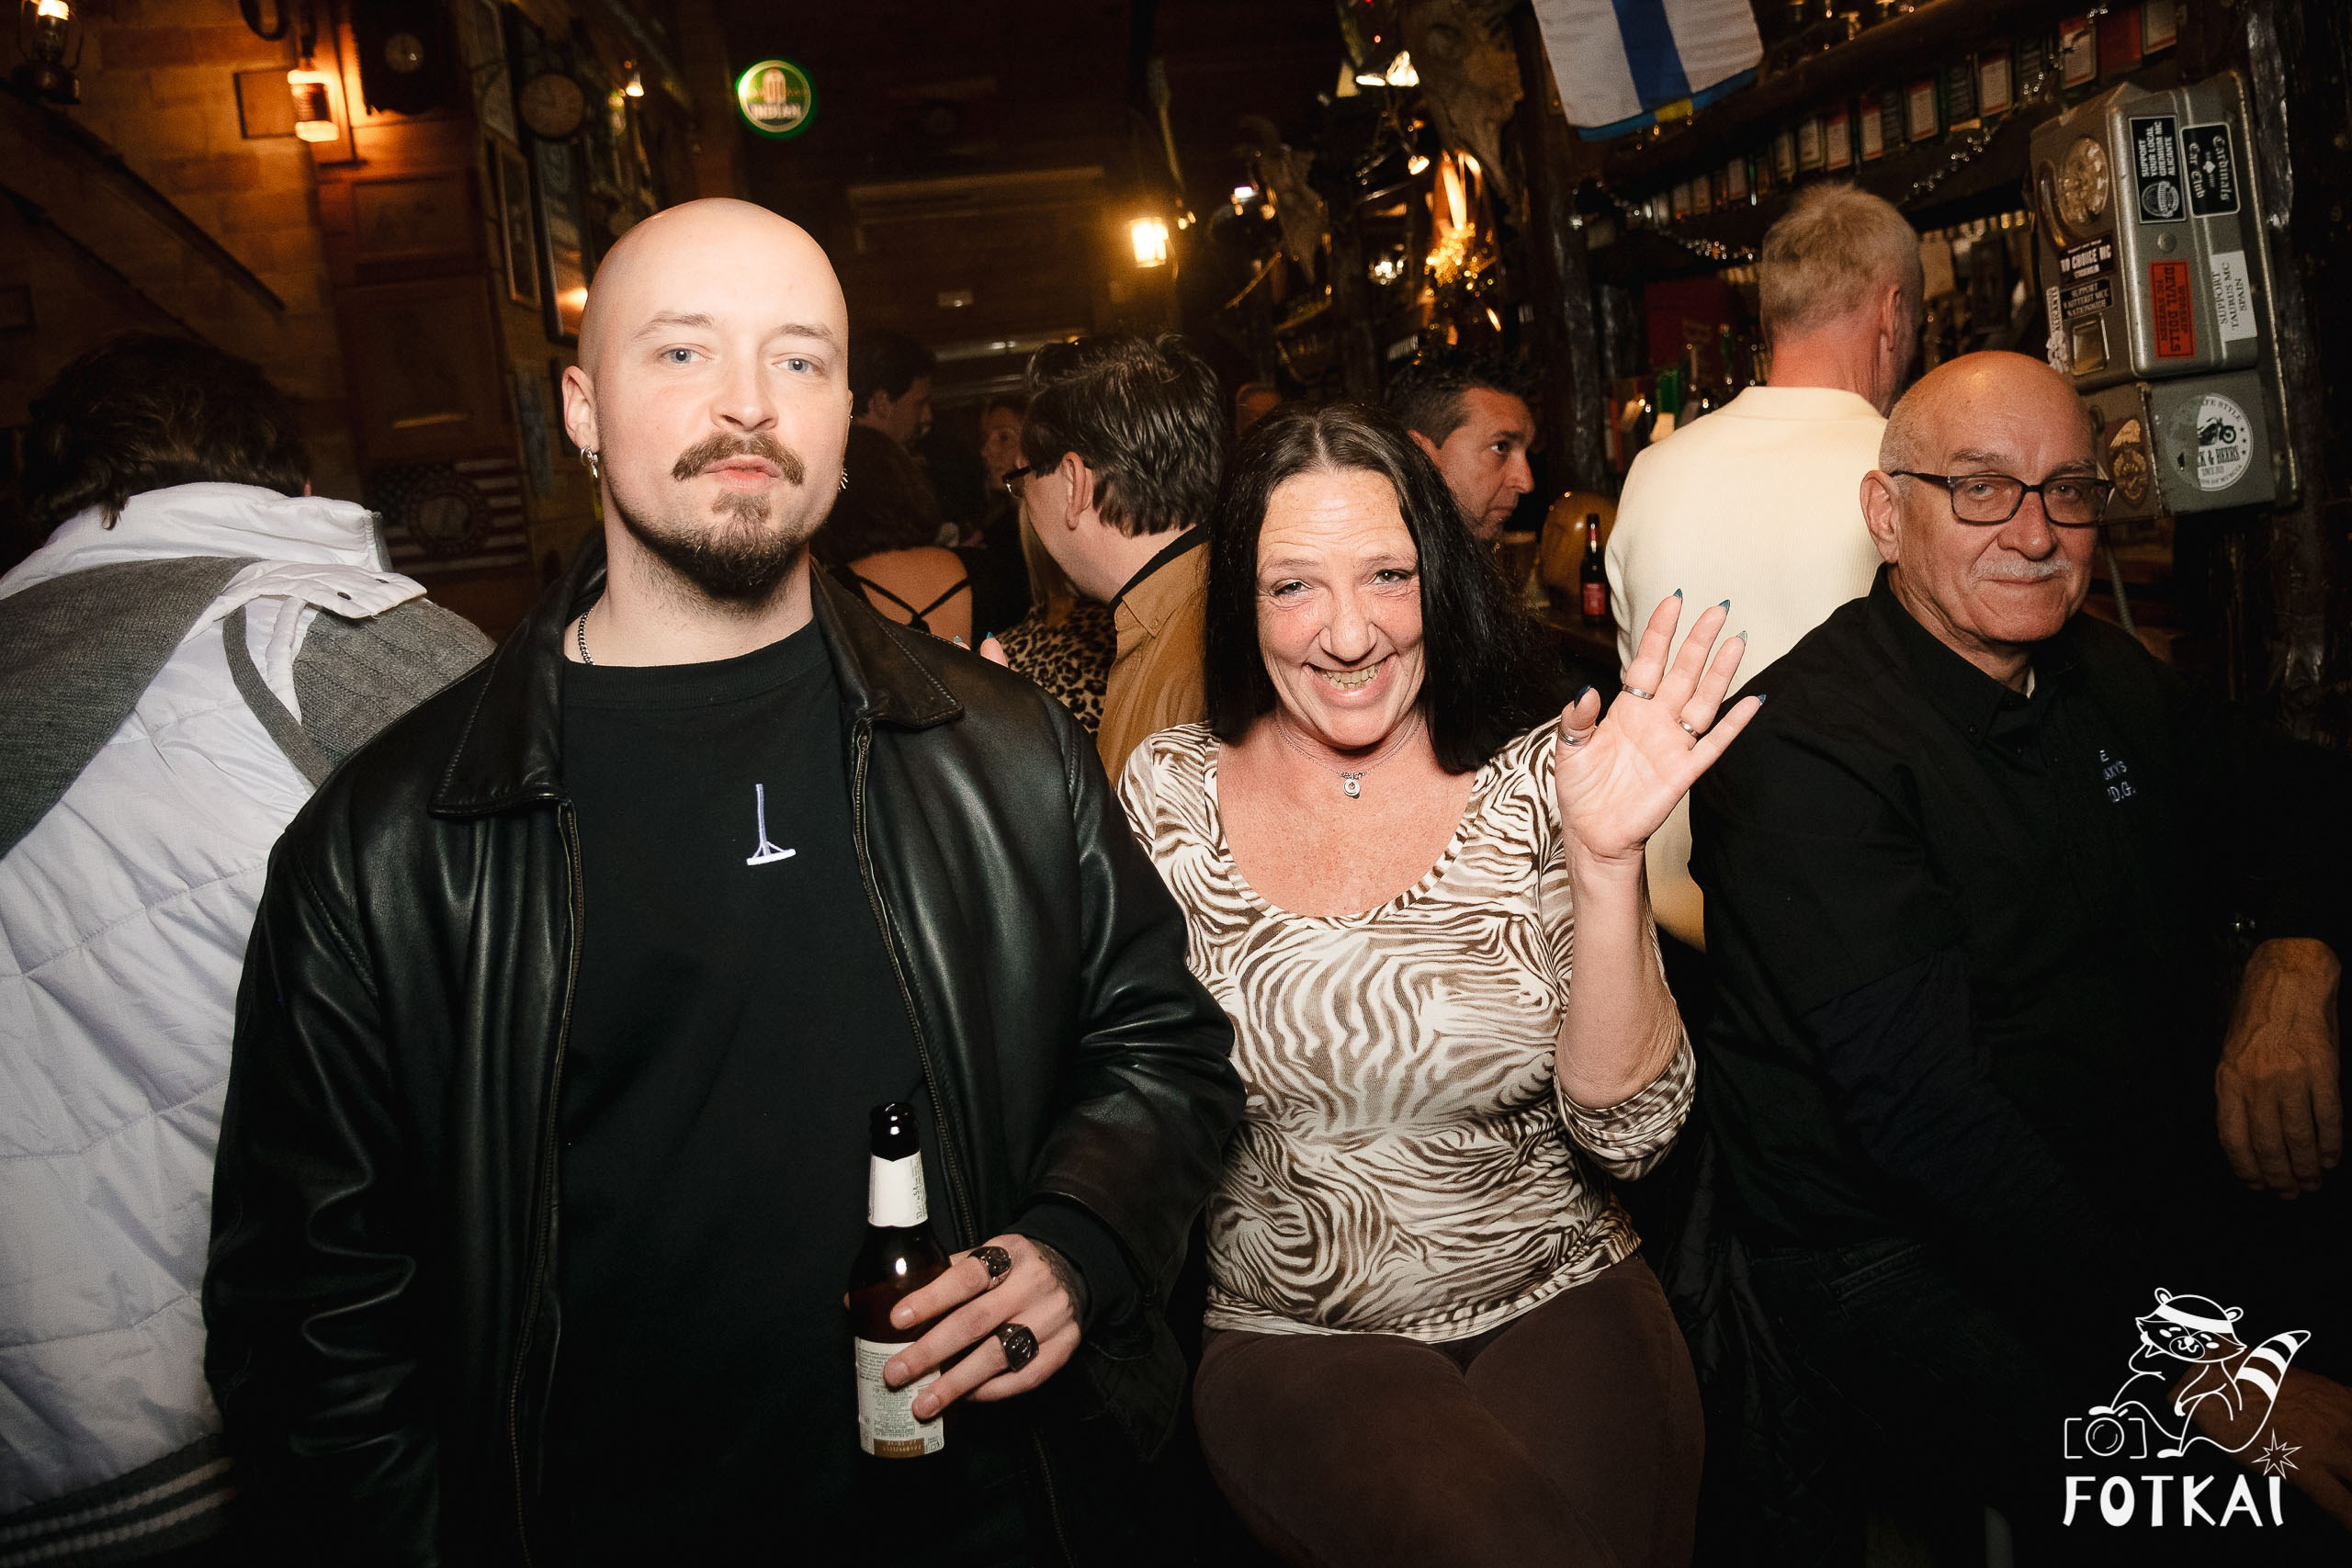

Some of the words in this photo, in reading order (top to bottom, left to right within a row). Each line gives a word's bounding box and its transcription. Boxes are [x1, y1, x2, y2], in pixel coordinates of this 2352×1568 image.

[2146, 127, 2154, 152] LOCAL
[2154, 121, 2162, 135] MC
[2138, 140, 2149, 177] SUPPORT
[2148, 154, 2157, 176] YOUR
[2165, 136, 2175, 175] ALICANTE
[2189, 142, 2200, 165] Car
[2212, 135, 2232, 201] Cardinals
[2191, 171, 2206, 197] Club
[2165, 266, 2177, 307] DEVIL
[2222, 263, 2232, 281] MC
[2212, 272, 2227, 324] SUPPORT
[2225, 285, 2239, 328] TAURUS
[2234, 278, 2247, 311] SPAIN
[2168, 310, 2180, 352] DOLLS
